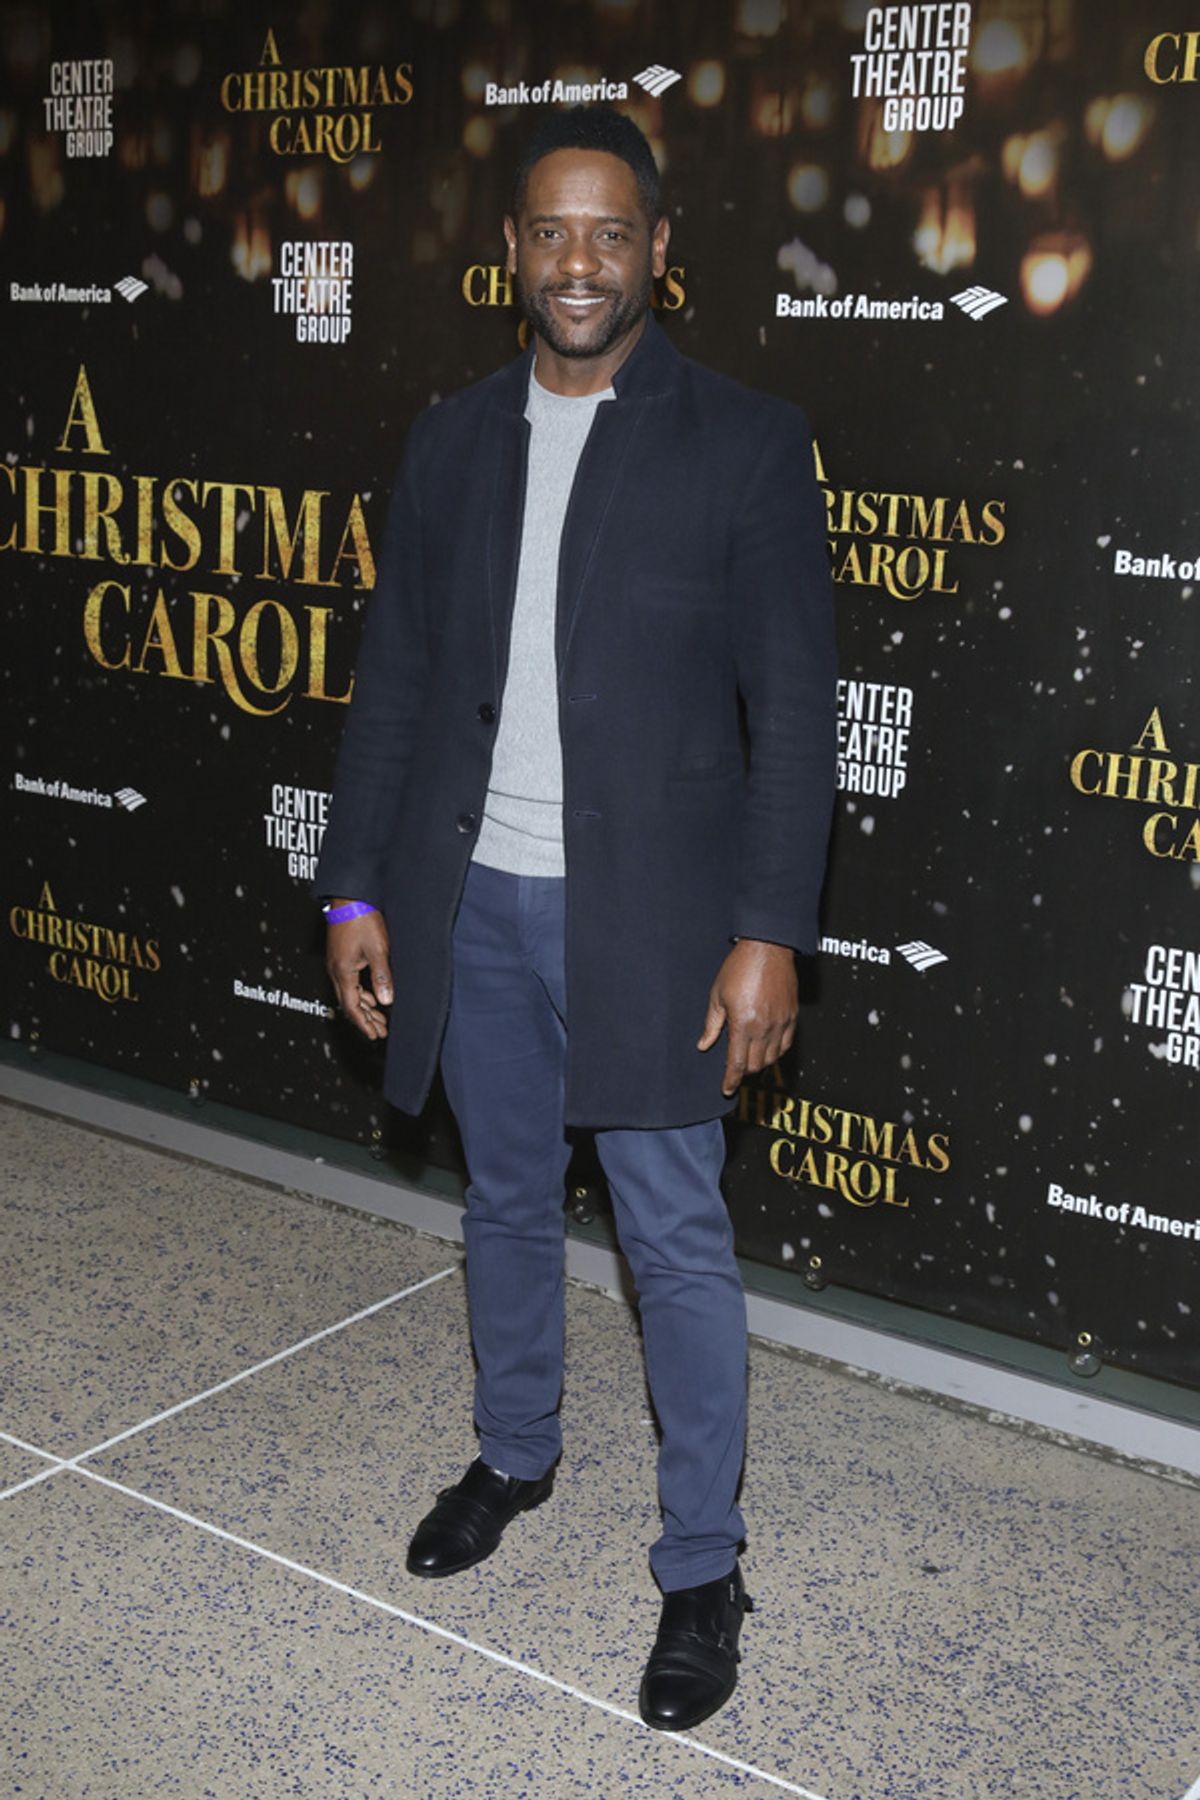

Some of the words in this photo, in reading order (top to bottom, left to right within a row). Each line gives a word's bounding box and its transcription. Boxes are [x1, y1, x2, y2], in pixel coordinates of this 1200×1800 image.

[259, 27, 282, 66] A
[865, 2, 971, 52] CENTER
[50, 59, 114, 96] CENTER
[220, 63, 414, 112] CHRISTMAS
[485, 82, 530, 106] Bank
[531, 80, 551, 104] of
[551, 78, 628, 103] America
[850, 49, 968, 98] THEATRE
[43, 96, 113, 131] THEATRE
[883, 96, 964, 132] GROUP
[66, 131, 113, 158] GROUP
[269, 113, 382, 163] CAROL
[281, 241, 354, 278] CENTER
[10, 282, 42, 301] Bank
[43, 282, 57, 302] of
[58, 283, 111, 303] America
[272, 278, 352, 315] THEATRE
[776, 293, 829, 318] Bank
[829, 294, 854, 319] of
[853, 295, 944, 320] America
[296, 316, 351, 343] GROUP
[56, 364, 110, 455] A
[0, 463, 377, 590] HRISTMA
[827, 539, 959, 601] AROL
[1114, 550, 1177, 579] Bank
[83, 580, 355, 716] CAROL
[836, 679, 914, 728] ENTER
[836, 720, 911, 768] EATRE
[1131, 706, 1171, 753] A
[15, 772, 46, 795] Bank
[46, 780, 60, 798] of
[60, 781, 113, 809] America
[836, 759, 907, 799] GROUP
[1070, 749, 1200, 810] CHRI
[271, 784, 333, 824] CENTE
[263, 814, 327, 855] THEAT
[38, 880, 56, 912] A
[10, 906, 161, 972] CHRISTMAS
[817, 935, 891, 966] merica
[50, 951, 139, 1003] CAROL
[234, 979, 266, 1003] Bank
[266, 989, 281, 1006] of
[769, 1137, 909, 1208] CAROL
[1048, 1183, 1103, 1219] Bank
[1103, 1202, 1131, 1224] of
